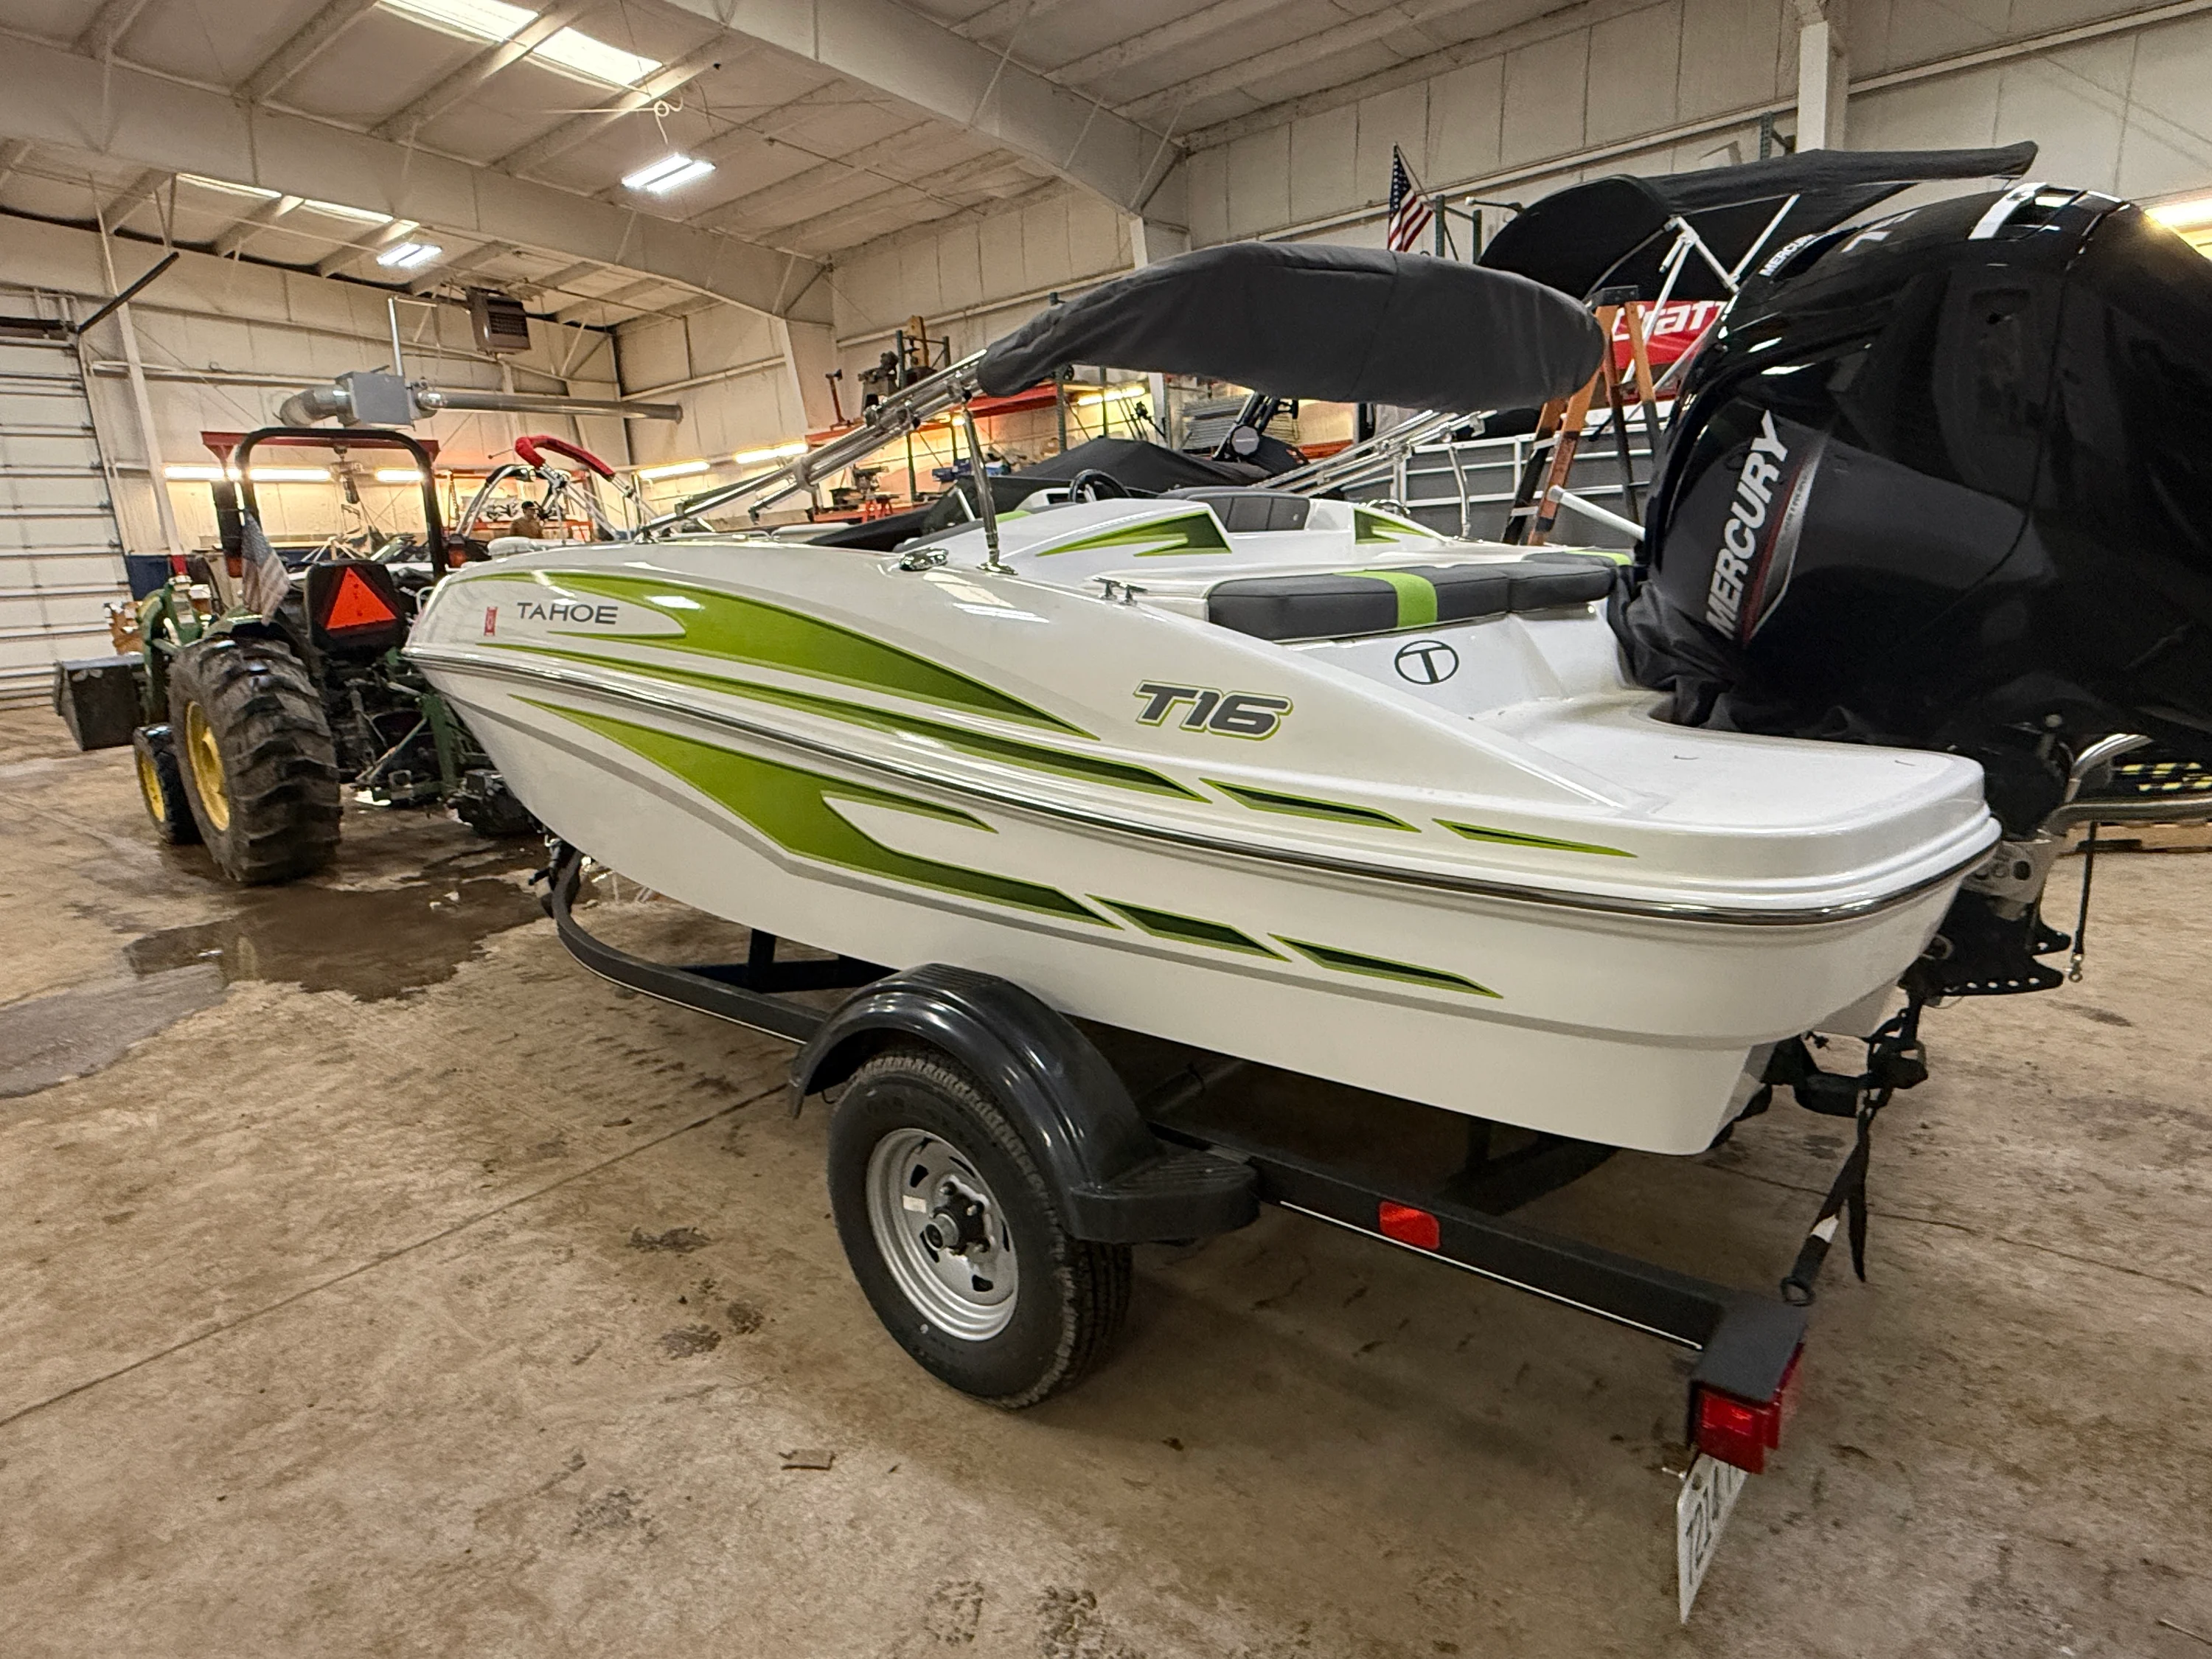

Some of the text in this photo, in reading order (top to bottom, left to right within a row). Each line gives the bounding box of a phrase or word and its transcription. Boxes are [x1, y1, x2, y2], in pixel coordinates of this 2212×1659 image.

[1706, 409, 1788, 641] MERCURY
[517, 602, 618, 625] TAHOE
[1134, 681, 1293, 740] T16
